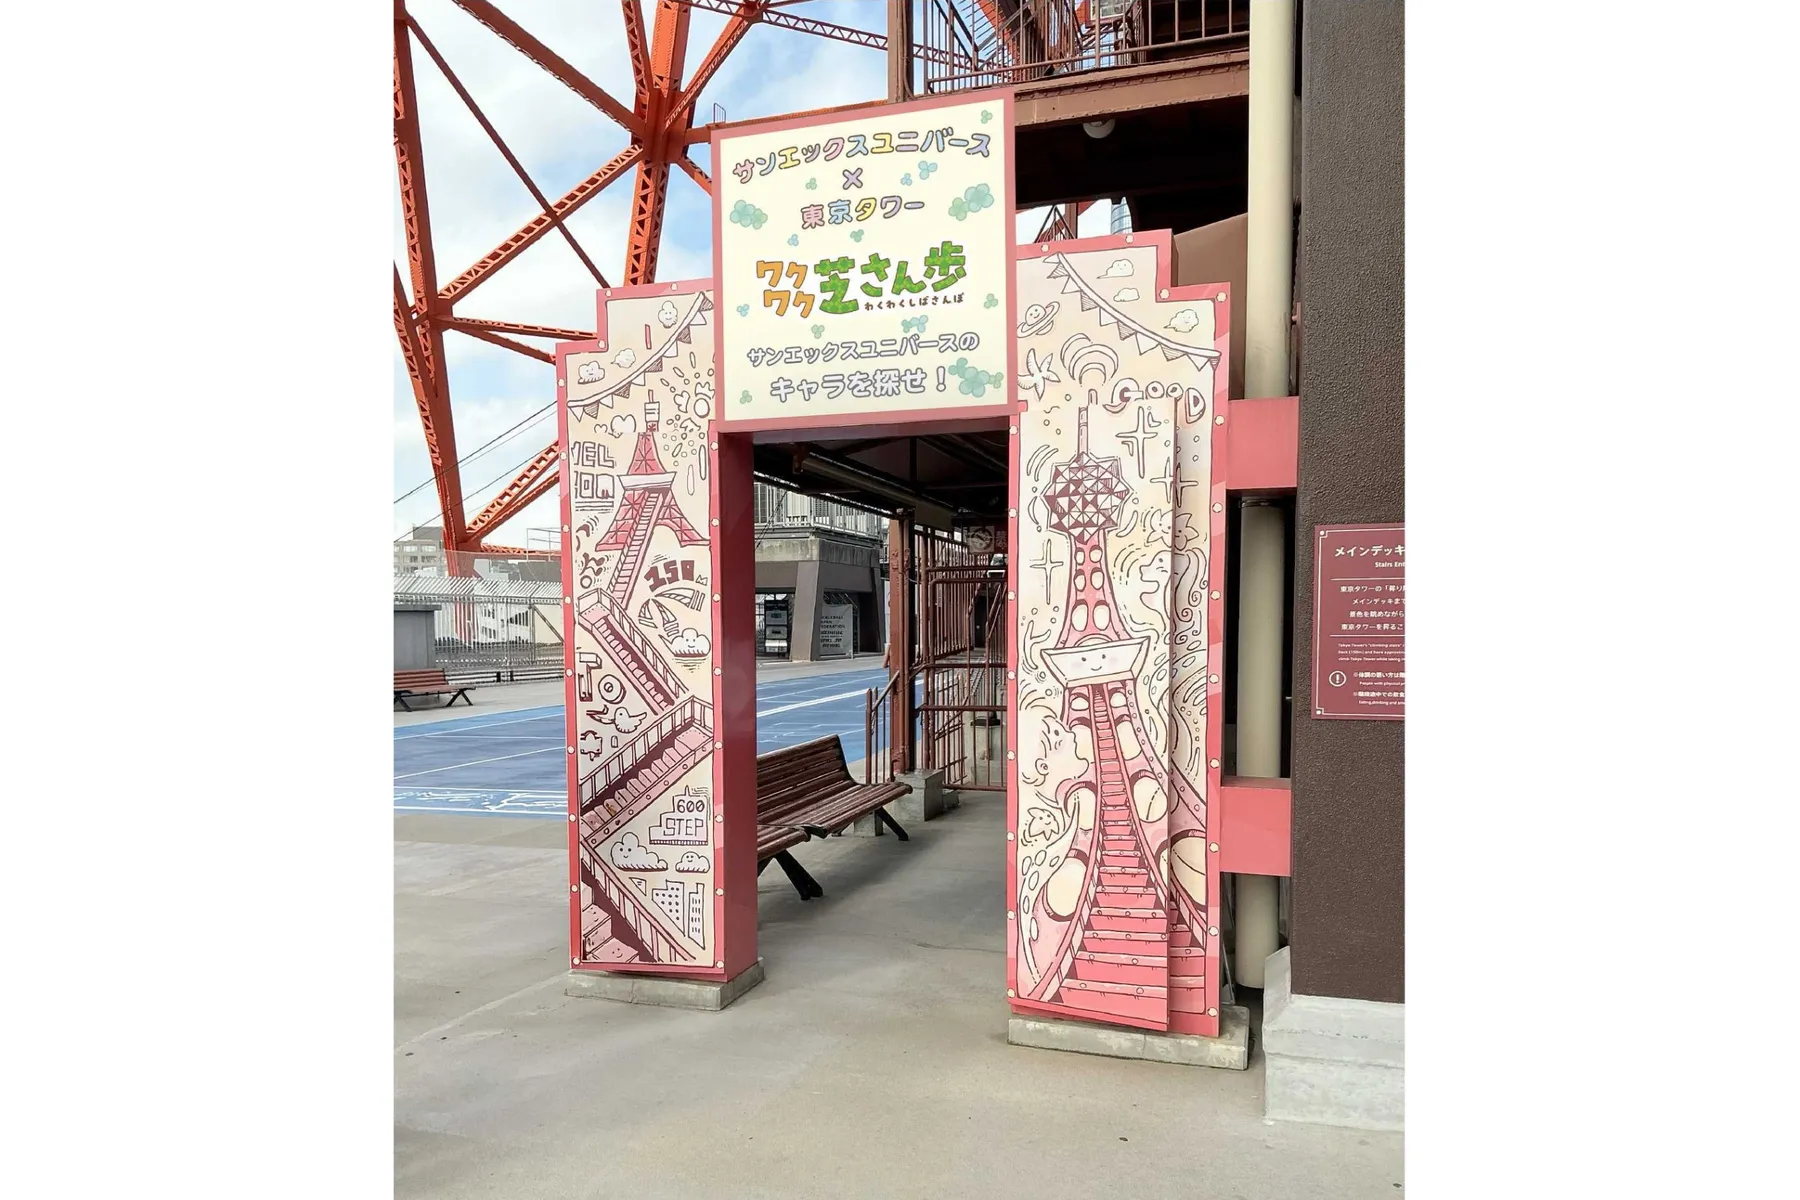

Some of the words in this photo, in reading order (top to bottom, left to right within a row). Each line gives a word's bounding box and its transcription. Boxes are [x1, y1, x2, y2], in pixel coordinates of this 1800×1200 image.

[732, 127, 991, 184] サンエックスユニバース
[801, 195, 925, 229] 東京タワー
[814, 240, 967, 314] 芝さん歩
[864, 292, 964, 311] わくわくしばさんぽ
[747, 332, 980, 367] サンエックスユニバースの
[1334, 545, 1405, 557] メインデッキ
[676, 799, 705, 813] 600
[663, 818, 704, 836] STEP
